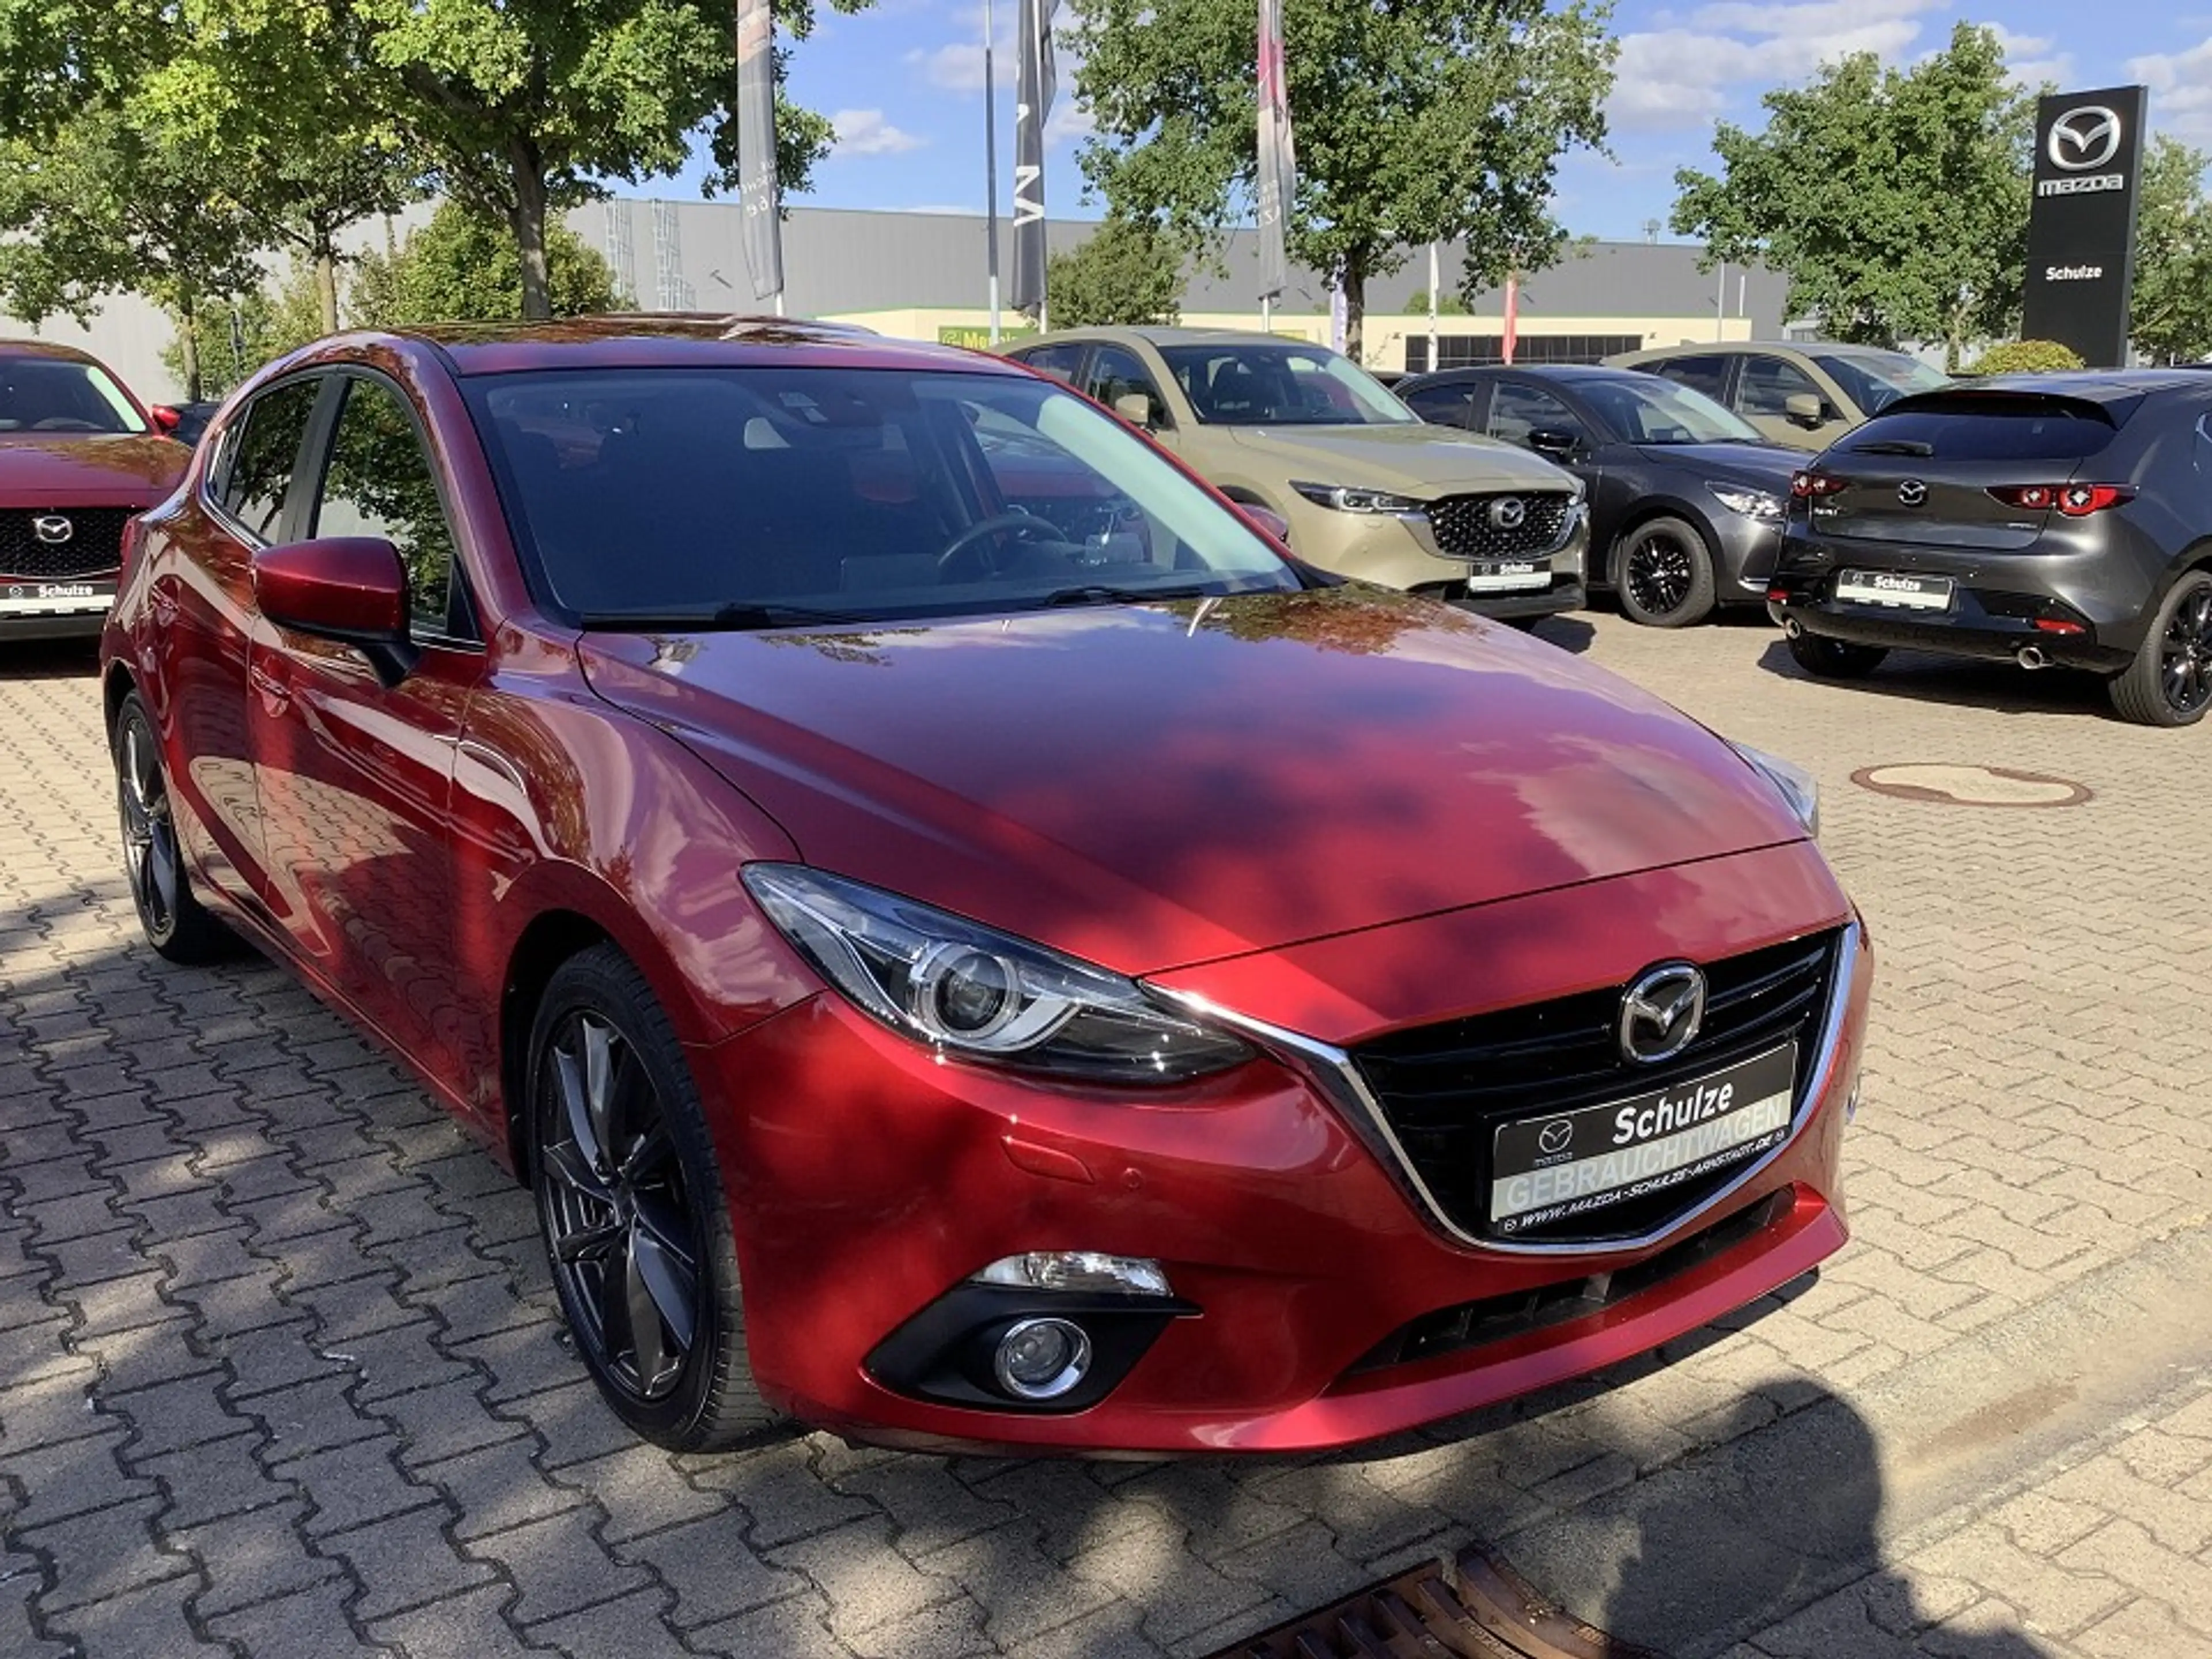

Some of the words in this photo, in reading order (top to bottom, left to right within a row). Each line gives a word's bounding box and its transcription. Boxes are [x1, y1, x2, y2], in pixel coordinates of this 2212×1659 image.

[2046, 264, 2102, 281] Schulze
[39, 584, 93, 597] Schulze
[1873, 575, 1921, 591] Schulze
[1612, 1082, 1734, 1144] Schulze
[1506, 1096, 1783, 1212] GEBRAUCHTWAGEN
